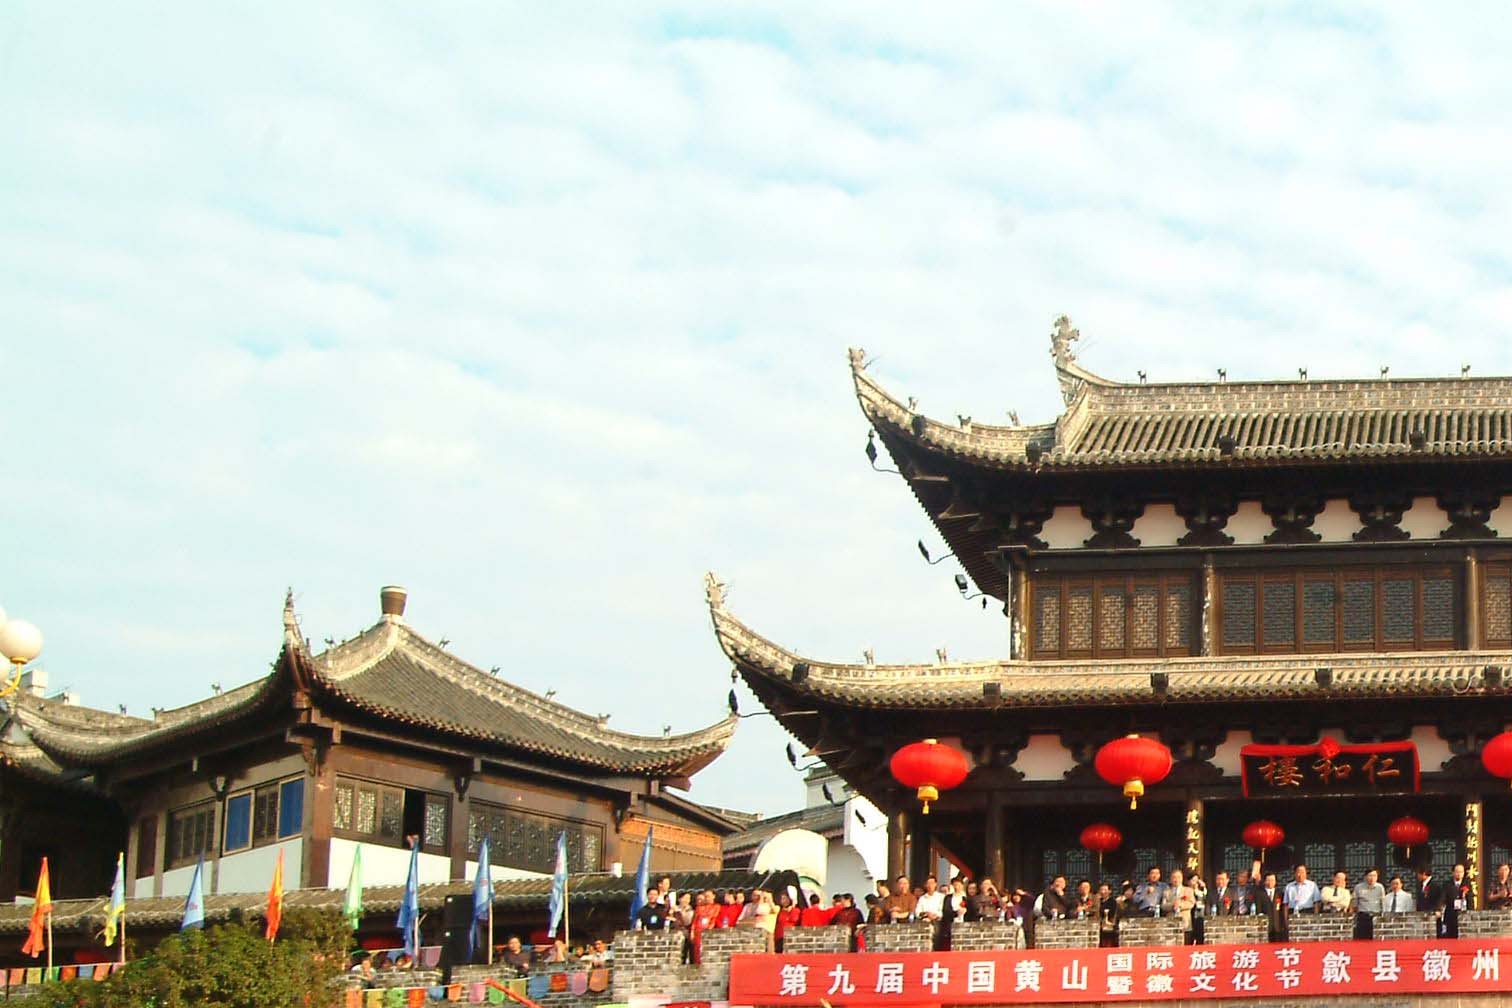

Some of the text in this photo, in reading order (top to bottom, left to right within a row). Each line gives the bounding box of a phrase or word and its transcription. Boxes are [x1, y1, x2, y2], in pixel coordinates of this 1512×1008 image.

[1106, 947, 1302, 973] 国际旅游节
[779, 959, 1088, 996] 第九届中国黄山
[1106, 970, 1302, 995] 暨徽文化节
